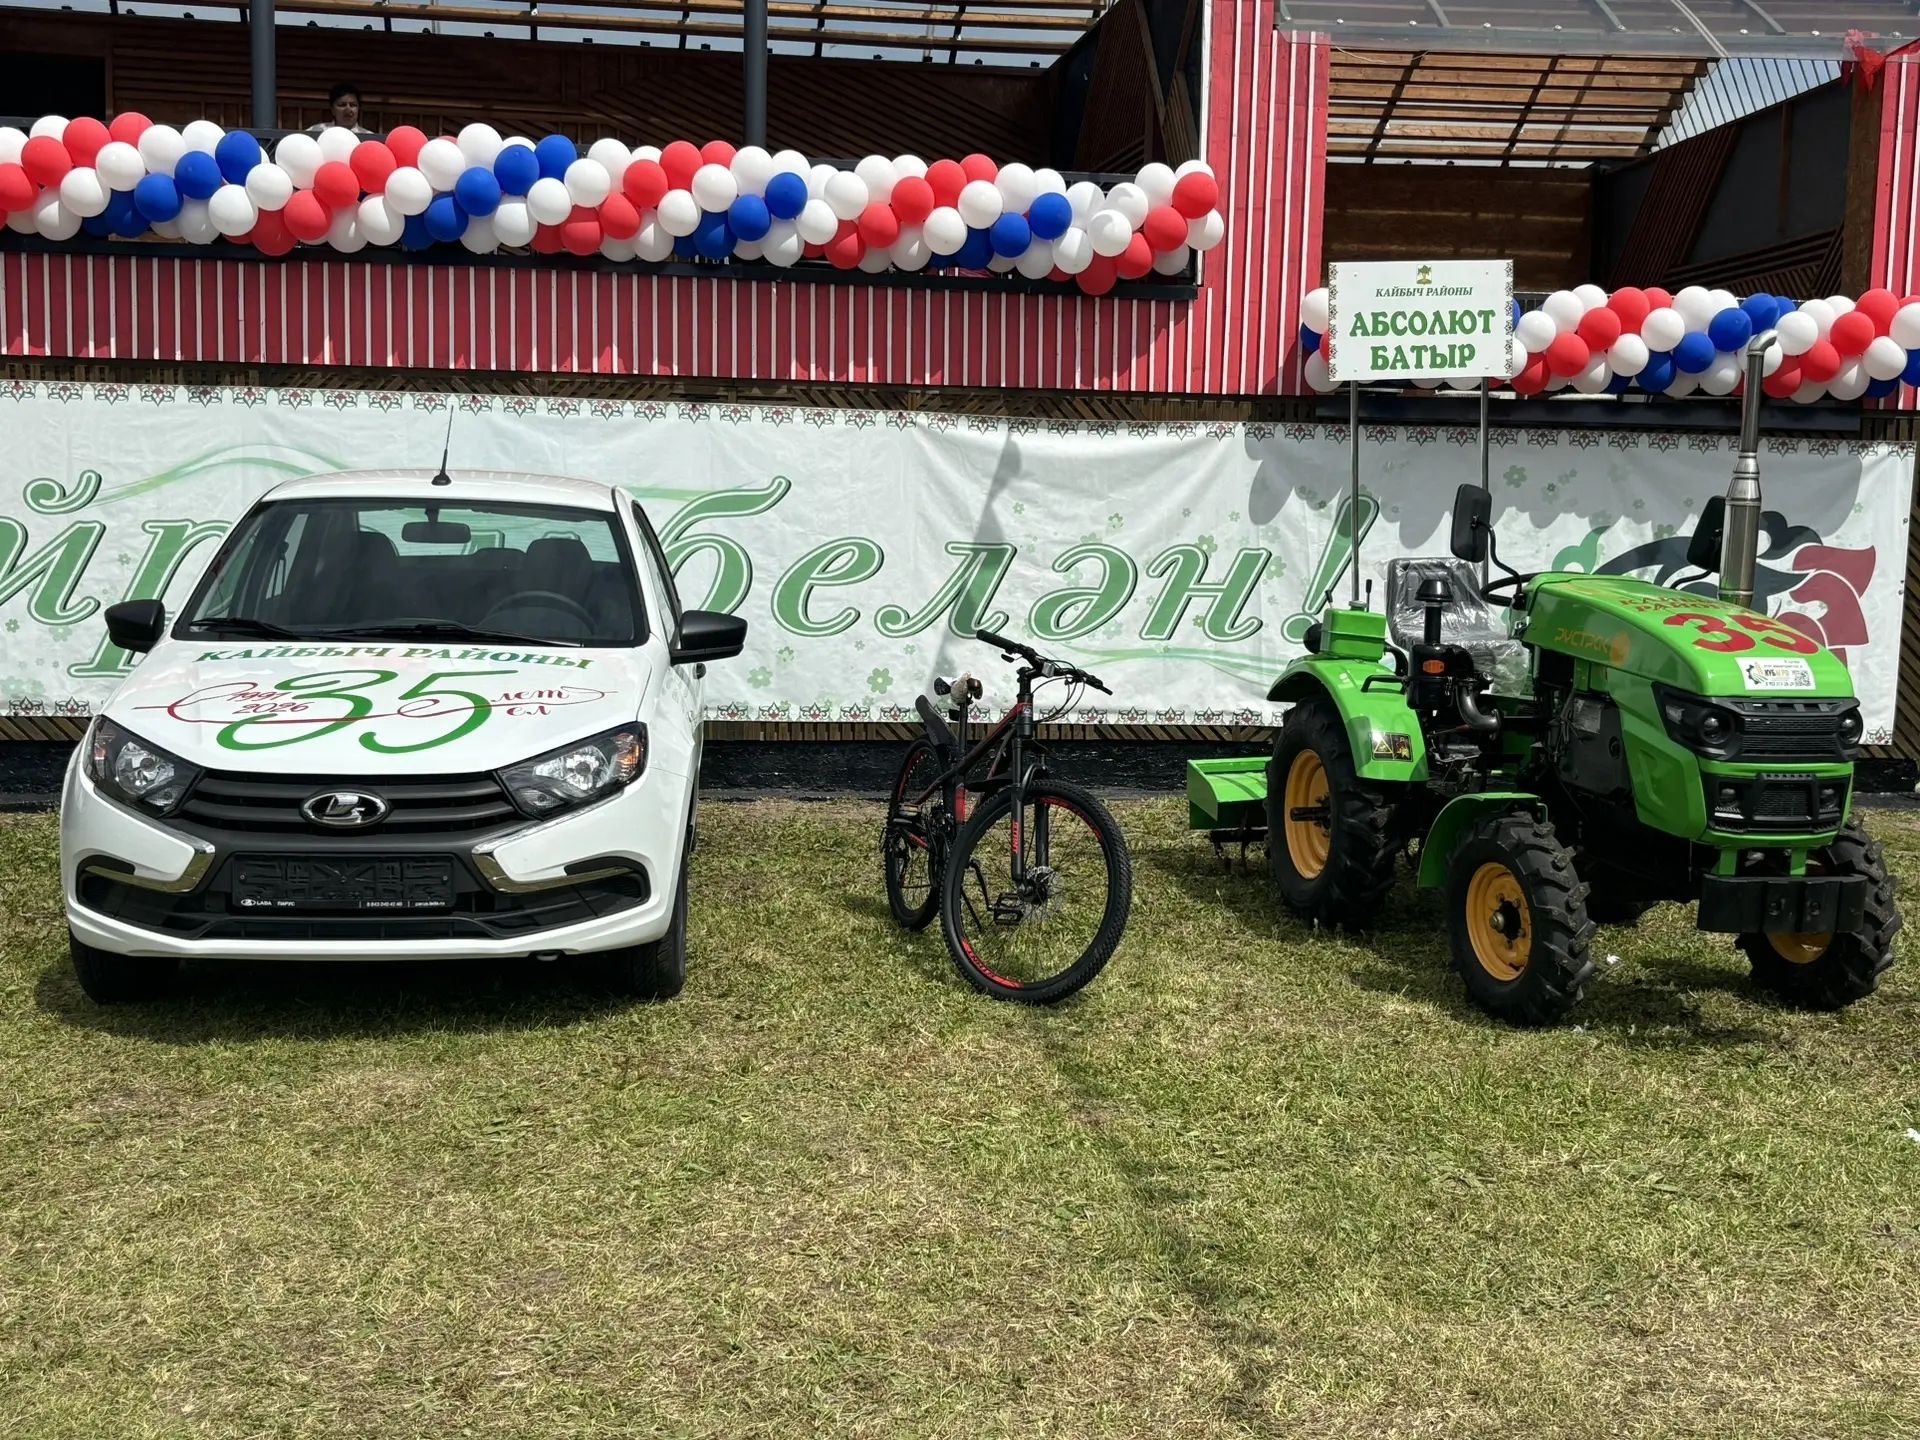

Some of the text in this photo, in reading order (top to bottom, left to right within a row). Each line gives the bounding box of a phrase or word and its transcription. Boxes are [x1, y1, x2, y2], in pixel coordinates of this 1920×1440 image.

[1375, 284, 1473, 298] КАЙБЫЧ РАЙОНЫ
[1349, 309, 1496, 338] АБСОЛЮТ
[1369, 343, 1476, 371] БАТЫР
[1662, 612, 1819, 655] 35
[192, 645, 596, 670] КАЙБЫЧ РАЙОНЫ
[216, 669, 519, 755] 35
[232, 701, 315, 714] 2026
